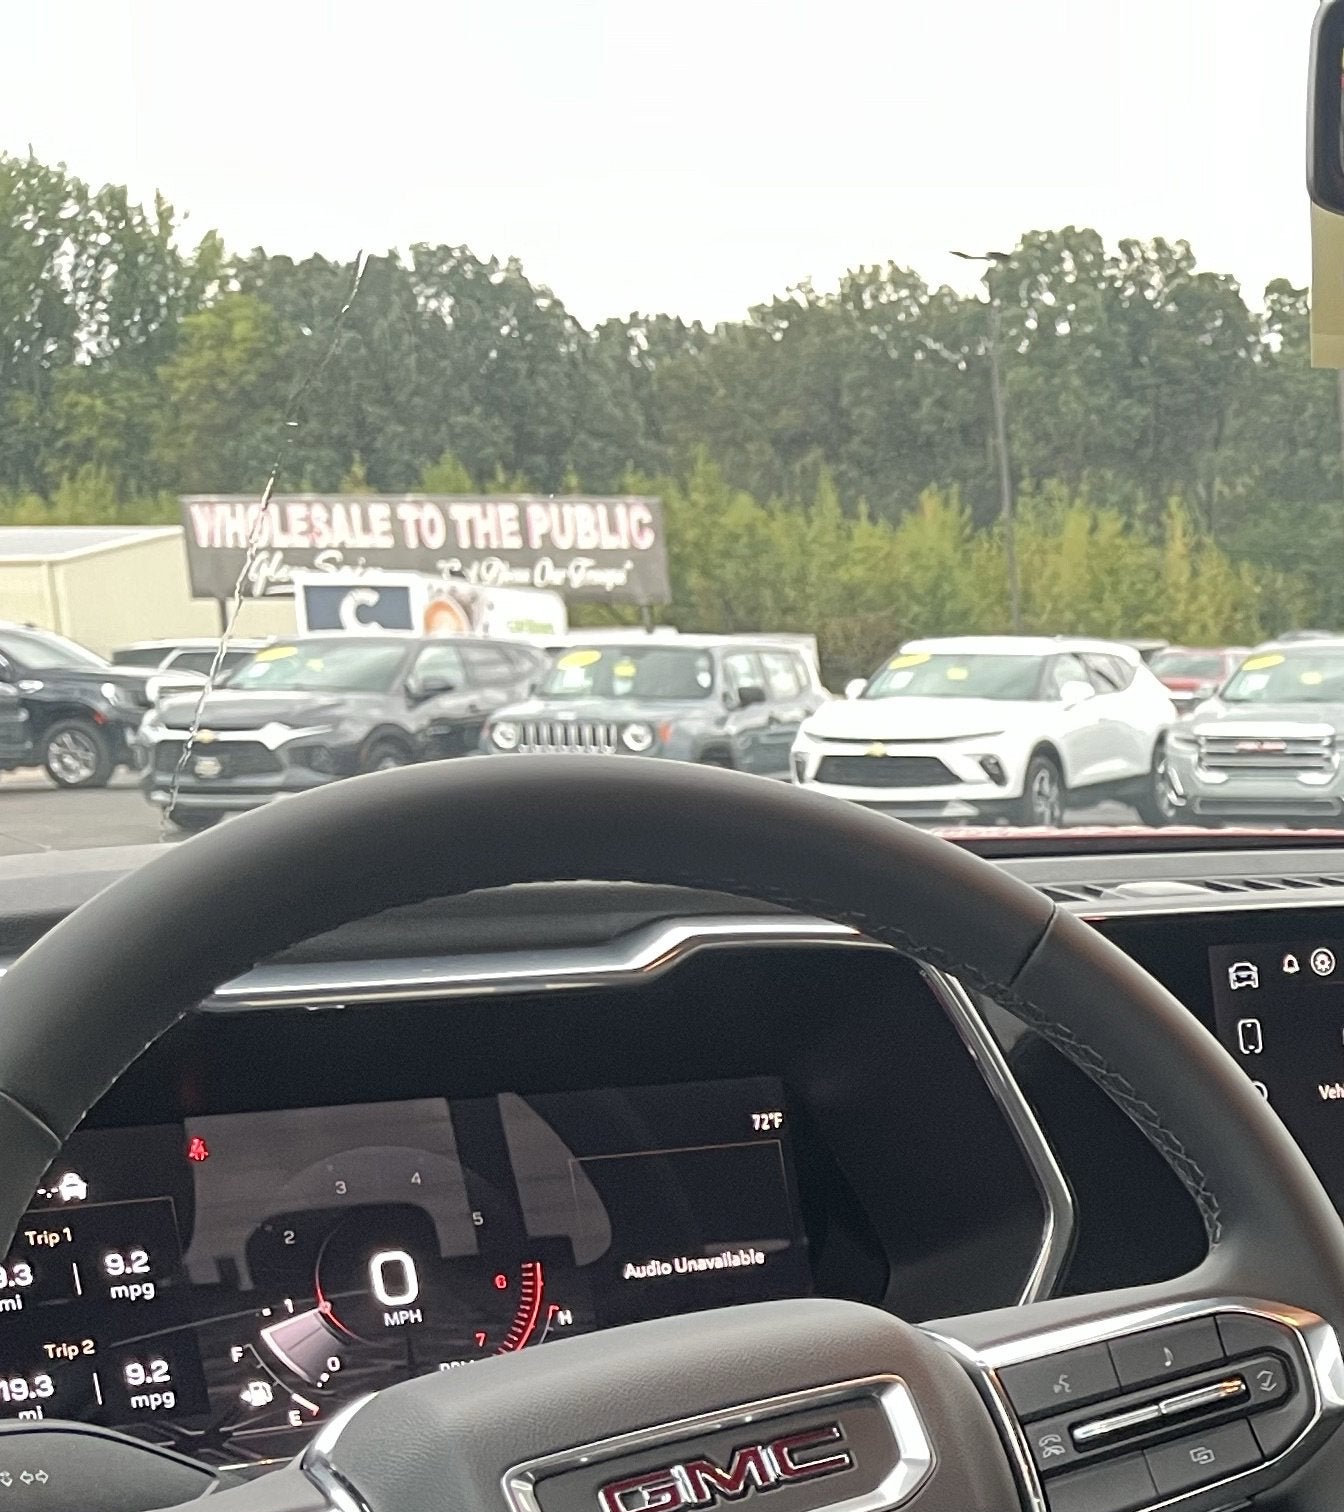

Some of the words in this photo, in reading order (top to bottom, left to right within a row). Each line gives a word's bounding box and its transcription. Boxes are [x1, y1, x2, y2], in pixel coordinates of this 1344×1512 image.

[190, 502, 395, 549] WHOLESALE
[397, 502, 447, 549] TO
[449, 501, 523, 549] THE
[527, 502, 656, 550] PUBLIC
[751, 1111, 783, 1132] 72°F
[335, 1180, 348, 1195] 3
[411, 1171, 422, 1185] 4
[472, 1211, 484, 1226] 5
[24, 1229, 60, 1247] Trip
[62, 1226, 73, 1243] 1
[283, 1230, 296, 1245] 2
[104, 1249, 151, 1276] 9.2
[622, 1260, 673, 1280] Audio
[673, 1248, 765, 1275] Unavailable
[368, 1250, 419, 1307] 0
[494, 1273, 508, 1289] 6
[0, 1293, 23, 1313] mi
[110, 1282, 155, 1301] mpg
[283, 1297, 295, 1315] 1
[384, 1308, 423, 1327] MPH
[43, 1342, 79, 1360] Trip
[81, 1339, 96, 1355] 2
[475, 1332, 487, 1348] 7
[231, 1345, 244, 1363] F
[0, 1374, 55, 1402] 19.3
[125, 1359, 172, 1386] 9.2
[18, 1405, 44, 1420] mi
[130, 1390, 176, 1410] mpg
[288, 1409, 303, 1427] E
